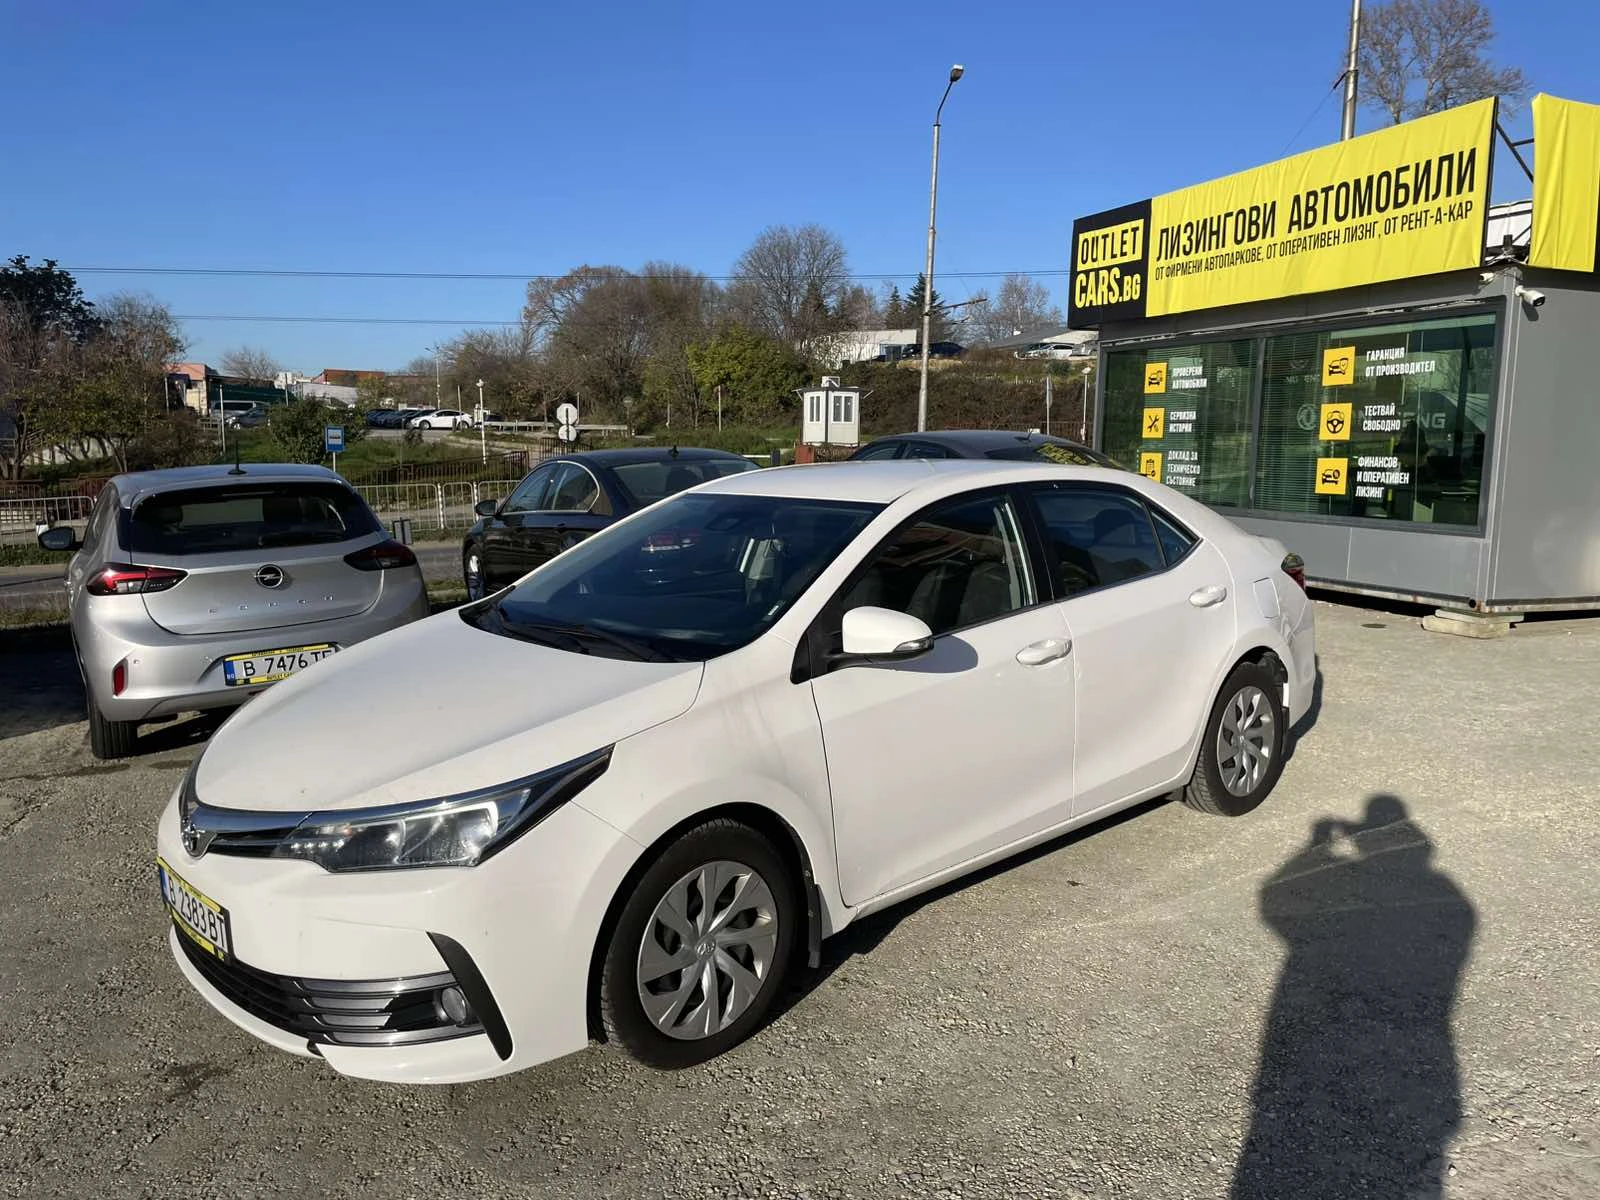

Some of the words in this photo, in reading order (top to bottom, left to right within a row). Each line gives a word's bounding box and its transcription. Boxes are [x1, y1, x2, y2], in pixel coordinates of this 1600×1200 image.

[1156, 200, 1276, 262] ЛИЗИНГОВИ
[1288, 147, 1477, 234] АВТОМОБИЛИ
[1081, 226, 1140, 265] OUTLET
[1155, 266, 1165, 281] ОТ
[1166, 257, 1203, 278] ФИРМЕНИ
[1204, 246, 1264, 272] АВТОПАРКОВЕ,
[1266, 242, 1278, 260] ОТ
[1279, 228, 1340, 257] ОПЕРАТИВЕН
[1384, 216, 1399, 235] ОТ
[1401, 200, 1473, 232] РЕНТ-А-КАР
[1075, 267, 1141, 309] CARS.BG
[1366, 347, 1405, 362] ГАРАНЦИЯ
[1365, 364, 1375, 377] ОТ
[1376, 360, 1436, 376] ПРОИЗВОДИТЕЛ
[1364, 402, 1396, 417] ТЕСТВАЙ
[1362, 419, 1400, 432] СВОБОДНО
[1357, 456, 1398, 468] ФИНАНСОВ
[1356, 472, 1362, 482] И
[1363, 471, 1410, 484] ОПЕРАТИВЕН
[1355, 486, 1385, 499] ЛИЗИНГ
[243, 661, 256, 677] B
[264, 653, 308, 674] 7476
[178, 886, 207, 934] 2383
[208, 908, 225, 948] BT
